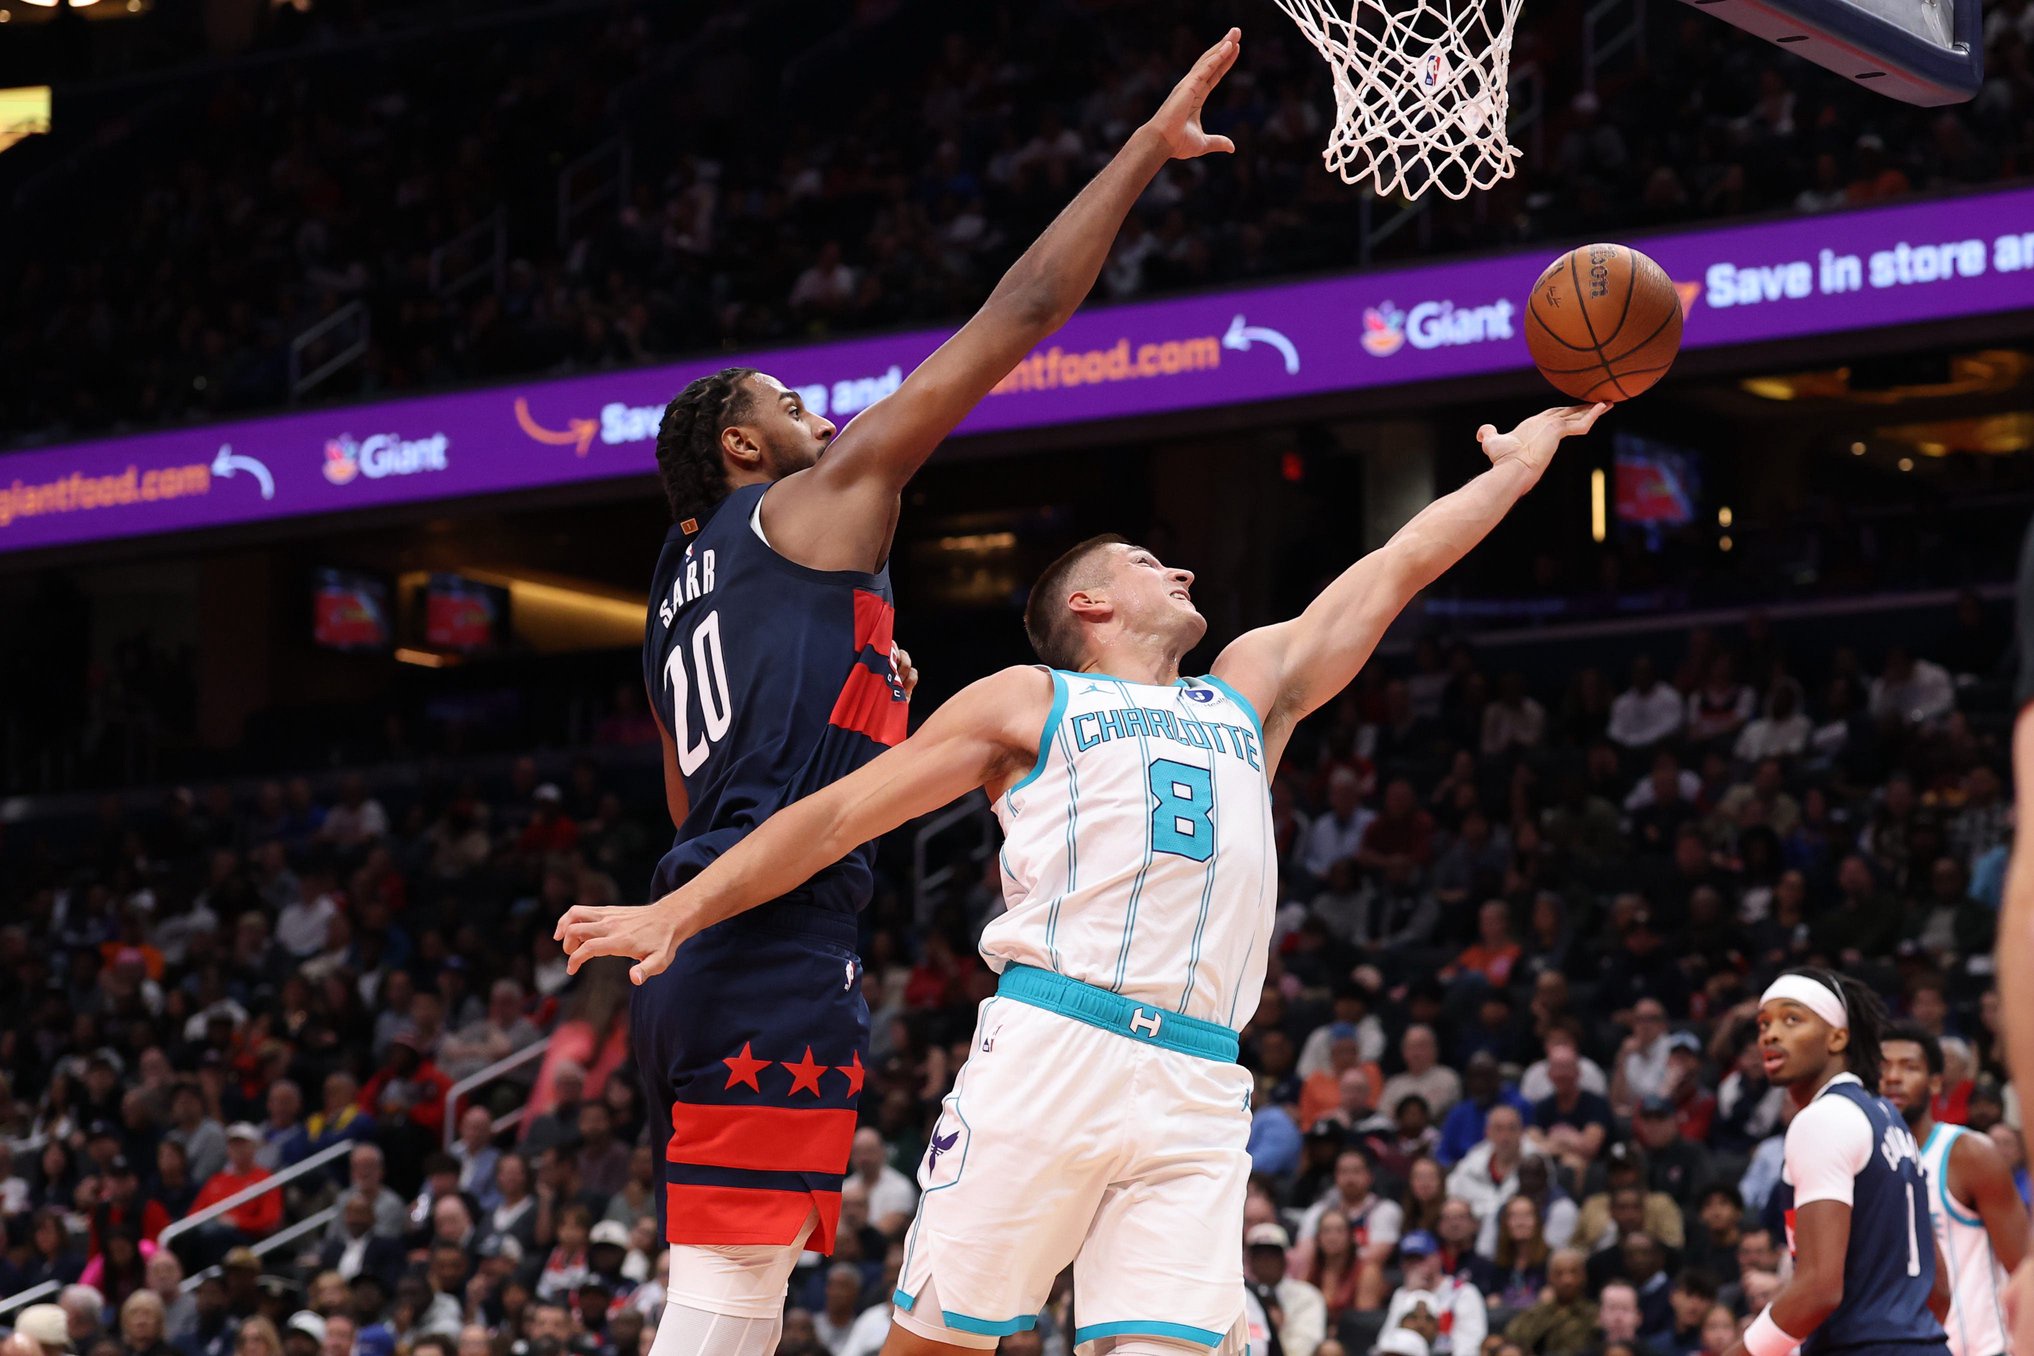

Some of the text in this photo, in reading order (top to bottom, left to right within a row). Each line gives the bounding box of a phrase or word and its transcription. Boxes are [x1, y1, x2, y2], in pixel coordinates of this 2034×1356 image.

[1705, 262, 1812, 308] Save
[1818, 248, 1862, 295] in
[1868, 241, 1987, 288] store
[1405, 299, 1515, 350] Giant
[359, 432, 449, 479] Giant
[659, 549, 716, 629] SARR
[664, 610, 732, 777] 20
[1071, 707, 1260, 772] CHARLOTTE
[1148, 757, 1215, 863] 8
[1905, 1182, 1921, 1277] 1
